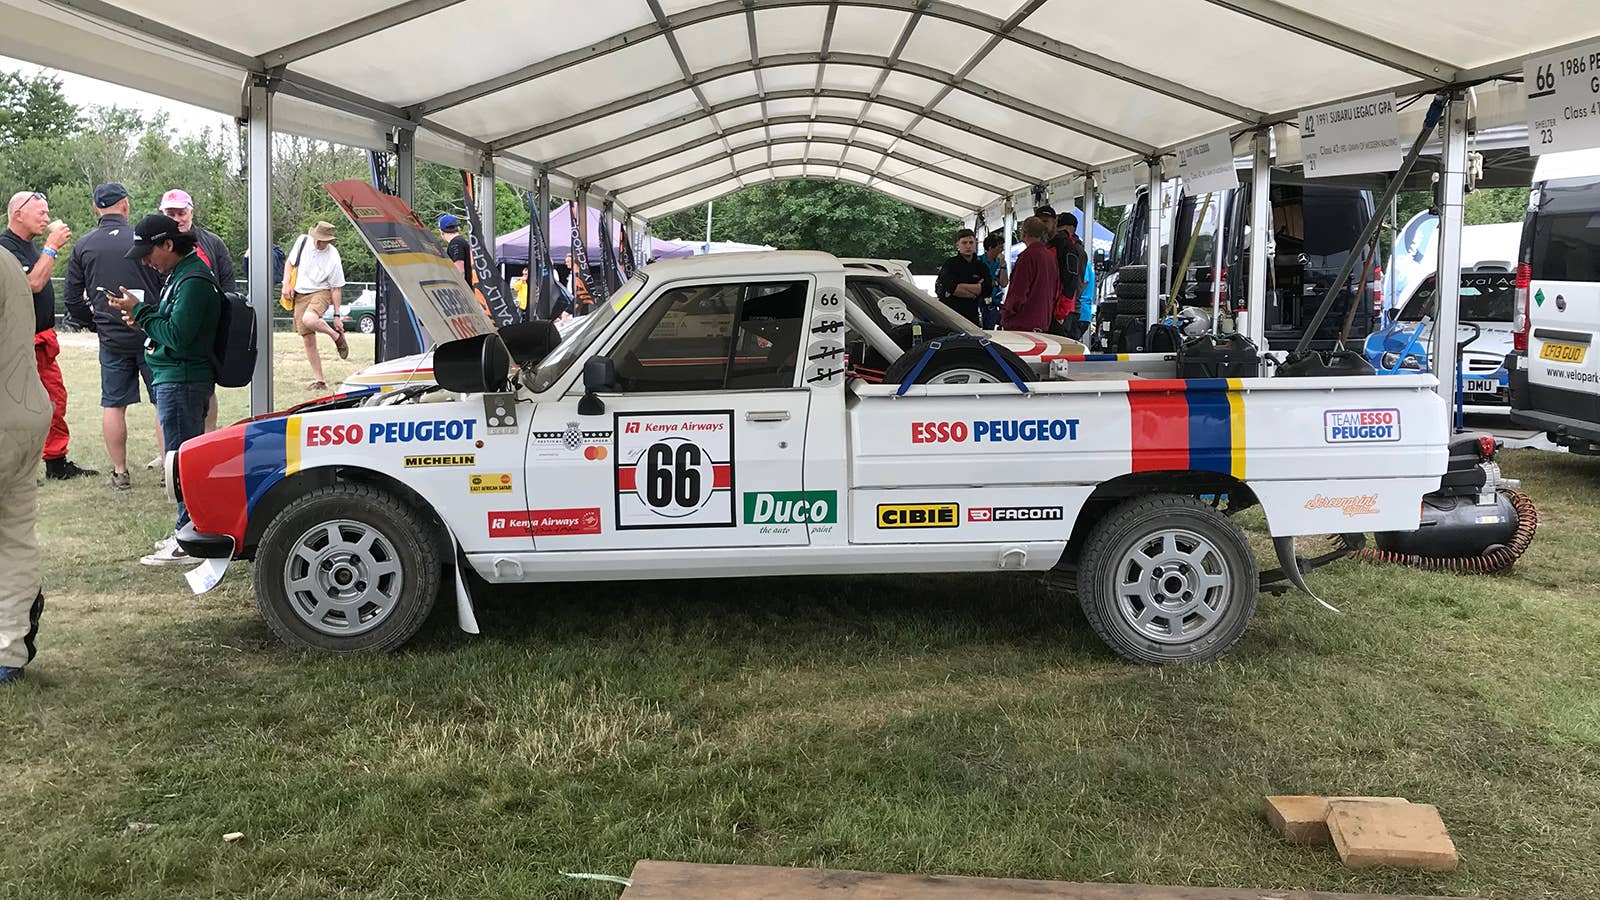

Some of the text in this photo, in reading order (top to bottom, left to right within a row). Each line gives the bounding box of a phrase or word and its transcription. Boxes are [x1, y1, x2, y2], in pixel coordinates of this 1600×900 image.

[1536, 64, 1555, 91] 66
[1560, 56, 1586, 77] 1986
[1305, 100, 1393, 133] 42 1991 SUBARU LEGACY GPA
[1563, 103, 1588, 120] Class
[1535, 118, 1557, 130] SHELTER
[1540, 128, 1553, 144] 23
[820, 293, 839, 306] 66
[893, 312, 906, 321] 42
[1467, 380, 1493, 392] DMU
[306, 418, 478, 447] ESSO PEUGEOT
[645, 423, 678, 433] Kenya
[681, 421, 724, 432] Airways
[911, 419, 1080, 444] ESSO PEUGEOT
[1331, 425, 1393, 439] PEUGEOT
[405, 456, 475, 466] MICHELIN
[647, 443, 701, 508] 66
[752, 493, 829, 523] Duco
[995, 507, 1062, 519] FACOM
[509, 518, 539, 528] Kenya
[541, 517, 580, 527] Airways
[759, 526, 772, 534] the
[811, 526, 833, 534] paint
